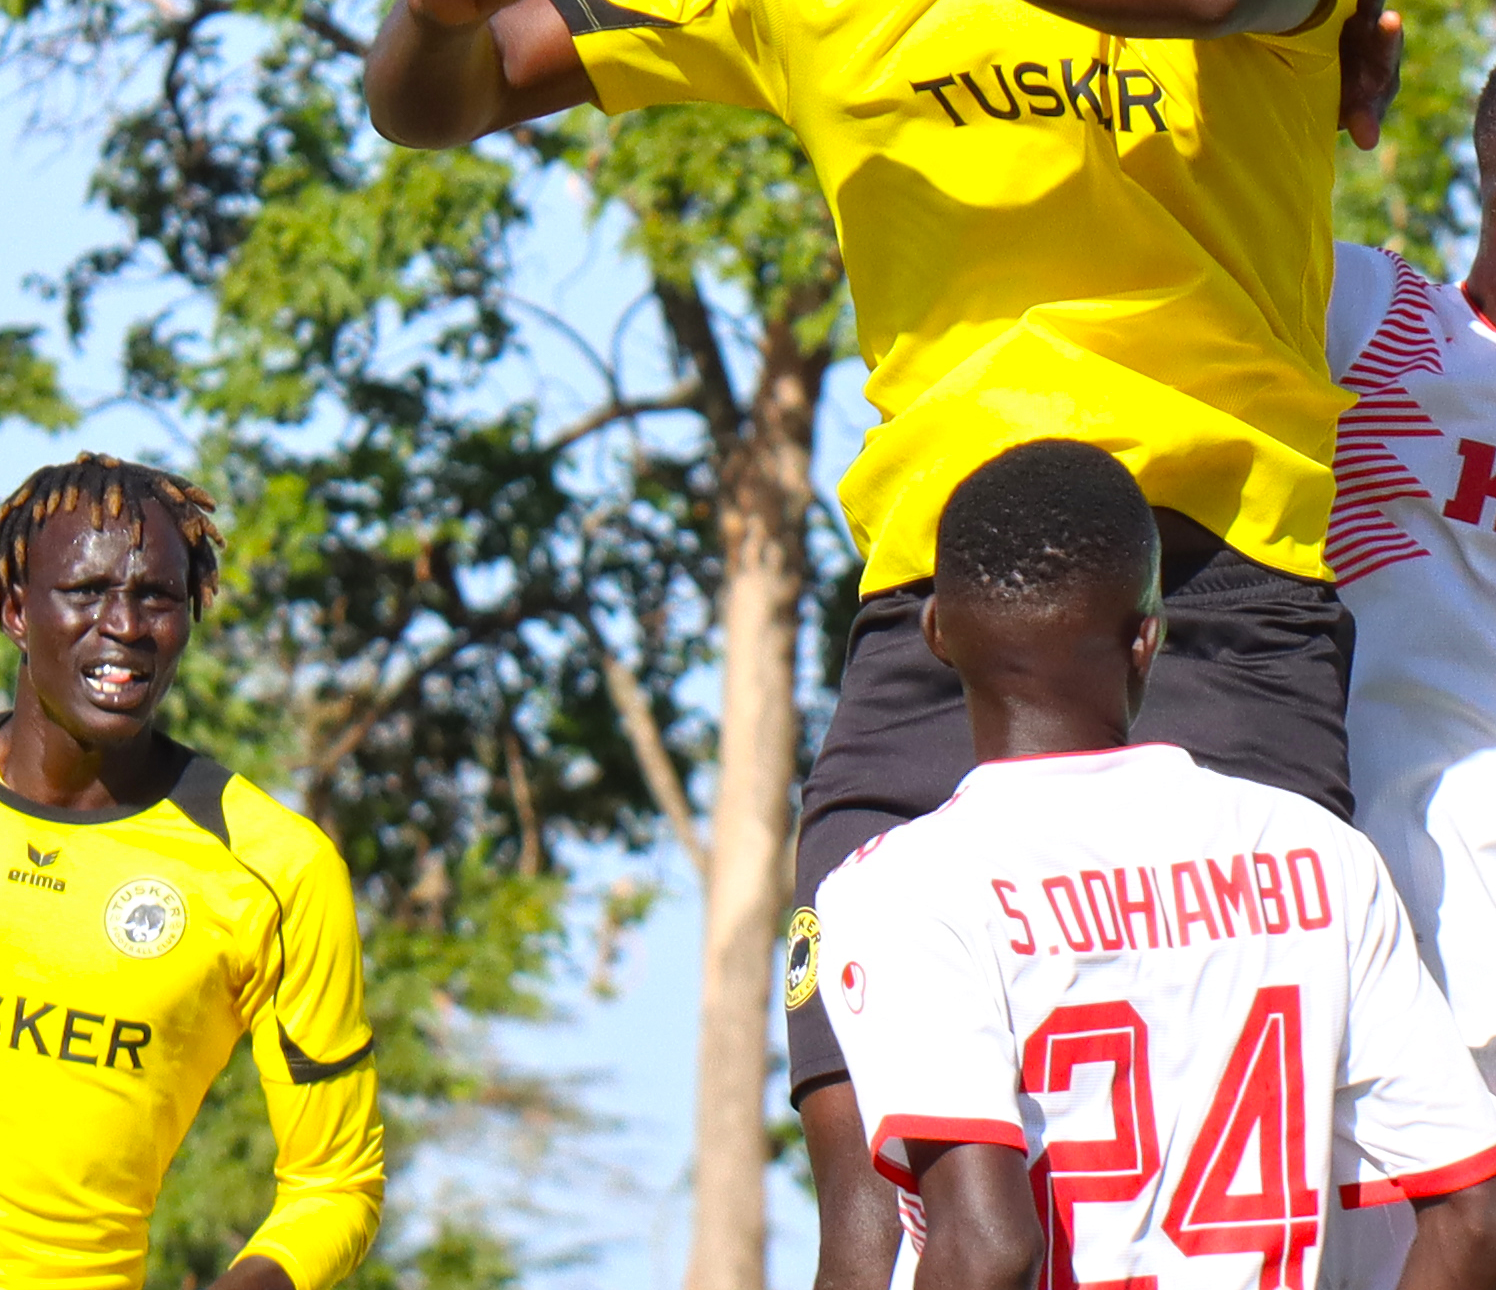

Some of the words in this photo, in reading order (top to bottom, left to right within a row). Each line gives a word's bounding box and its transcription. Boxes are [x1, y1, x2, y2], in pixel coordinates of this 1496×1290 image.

[908, 57, 1170, 134] TUSKR
[7, 867, 66, 893] erima
[111, 886, 182, 918] TUSKER
